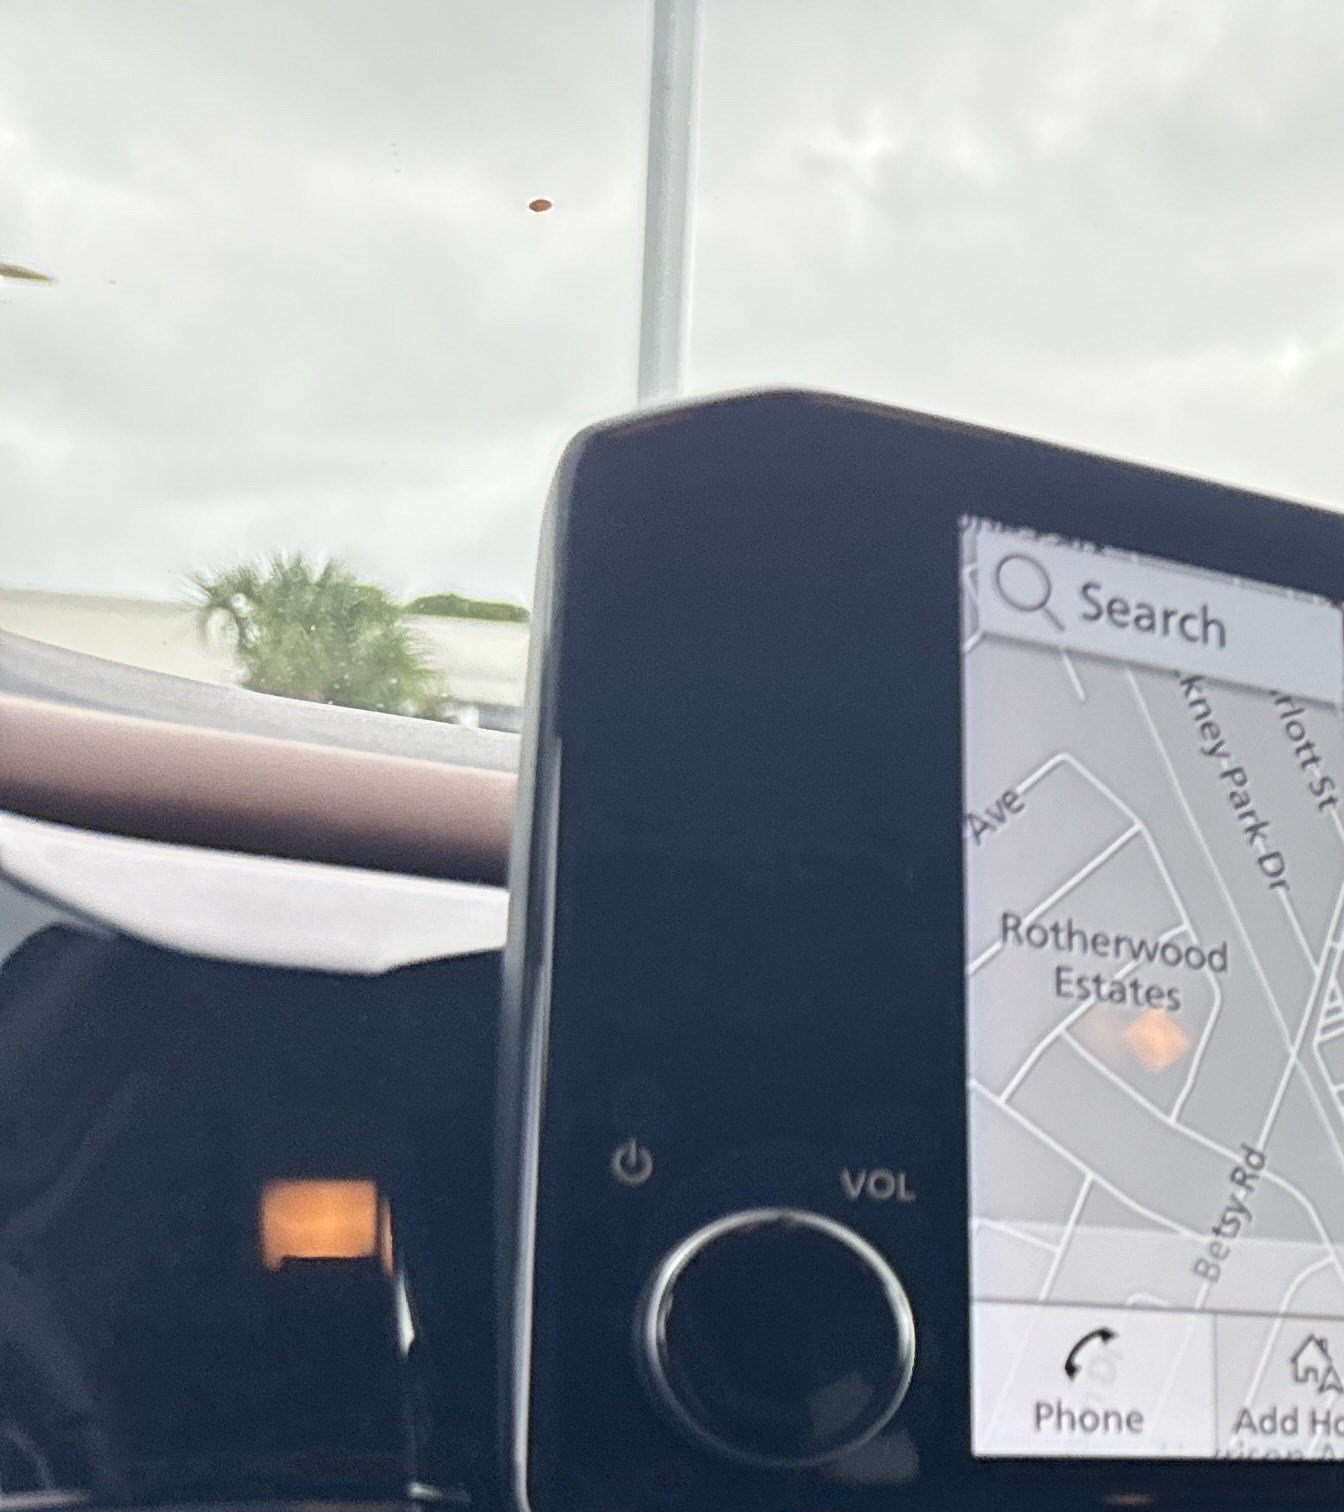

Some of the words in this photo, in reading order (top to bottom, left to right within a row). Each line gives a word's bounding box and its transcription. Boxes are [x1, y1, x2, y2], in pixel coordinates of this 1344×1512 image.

[1080, 581, 1228, 650] Search
[1268, 688, 1322, 771] rlott
[1309, 775, 1340, 812] St
[1173, 670, 1231, 758] kney
[1219, 766, 1270, 846] Park
[1257, 850, 1290, 892] Dr
[963, 788, 1027, 846] Ave
[1000, 911, 1230, 973] Rotherwood
[1055, 966, 1182, 1011] Estates
[839, 1166, 917, 1202] VOL
[1193, 1192, 1252, 1283] Betsy
[1230, 1143, 1268, 1193] Rd
[1034, 1402, 1144, 1436] Phone
[1231, 1405, 1299, 1436] Add
